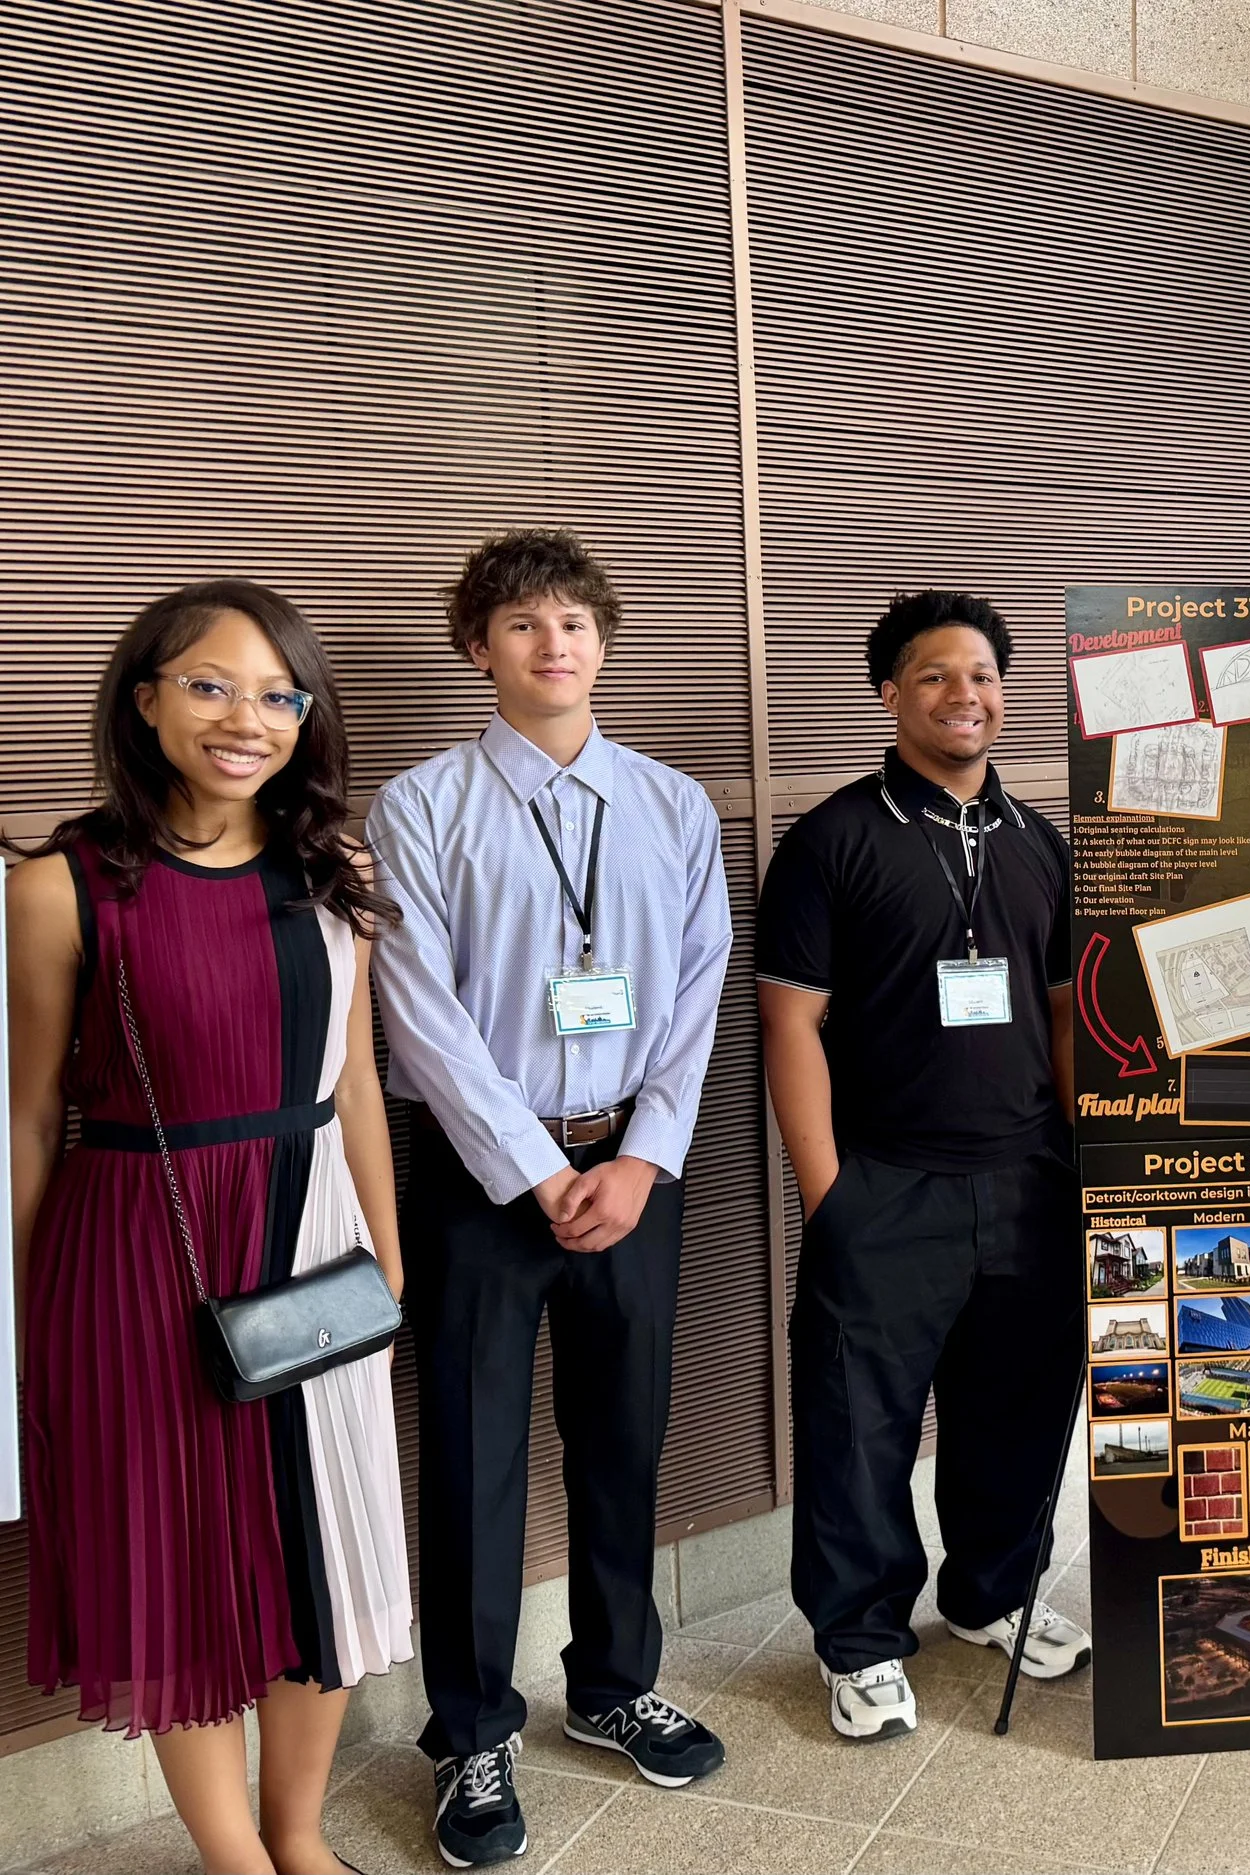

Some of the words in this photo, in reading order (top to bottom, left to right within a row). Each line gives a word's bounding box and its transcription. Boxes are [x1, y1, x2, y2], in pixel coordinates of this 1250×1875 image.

[1127, 595, 1226, 623] Project
[1068, 622, 1183, 653] Development
[1094, 790, 1106, 804] 3.
[1073, 815, 1105, 824] Element
[1106, 815, 1155, 825] explanations
[1111, 826, 1138, 834] seating
[1116, 837, 1125, 845] of
[1162, 837, 1181, 845] DCFC
[1183, 837, 1199, 846] sign
[1201, 838, 1217, 846] may
[1094, 850, 1114, 859] early
[1115, 849, 1141, 857] bubble
[1143, 849, 1174, 858] diagram
[1219, 848, 1238, 856] level
[1118, 861, 1149, 870] diagram
[1150, 860, 1159, 868] of
[1160, 860, 1173, 868] the
[1174, 860, 1198, 869] player
[1199, 860, 1217, 868] level
[1098, 873, 1128, 882] original
[1129, 872, 1149, 880] draft
[1150, 872, 1165, 880] Site
[1166, 872, 1184, 880] Plan
[1098, 896, 1134, 904] elevation
[1084, 908, 1108, 918] Player
[1149, 908, 1166, 917] plan
[1167, 1079, 1176, 1092] 7.
[1077, 1093, 1133, 1117] Final
[1135, 1097, 1182, 1122] plan
[1144, 1150, 1245, 1179] Project
[1086, 1188, 1197, 1204] Detroit/corktown
[1200, 1187, 1244, 1202] design
[1090, 1214, 1147, 1228] Historical
[1193, 1211, 1245, 1224] Modern
